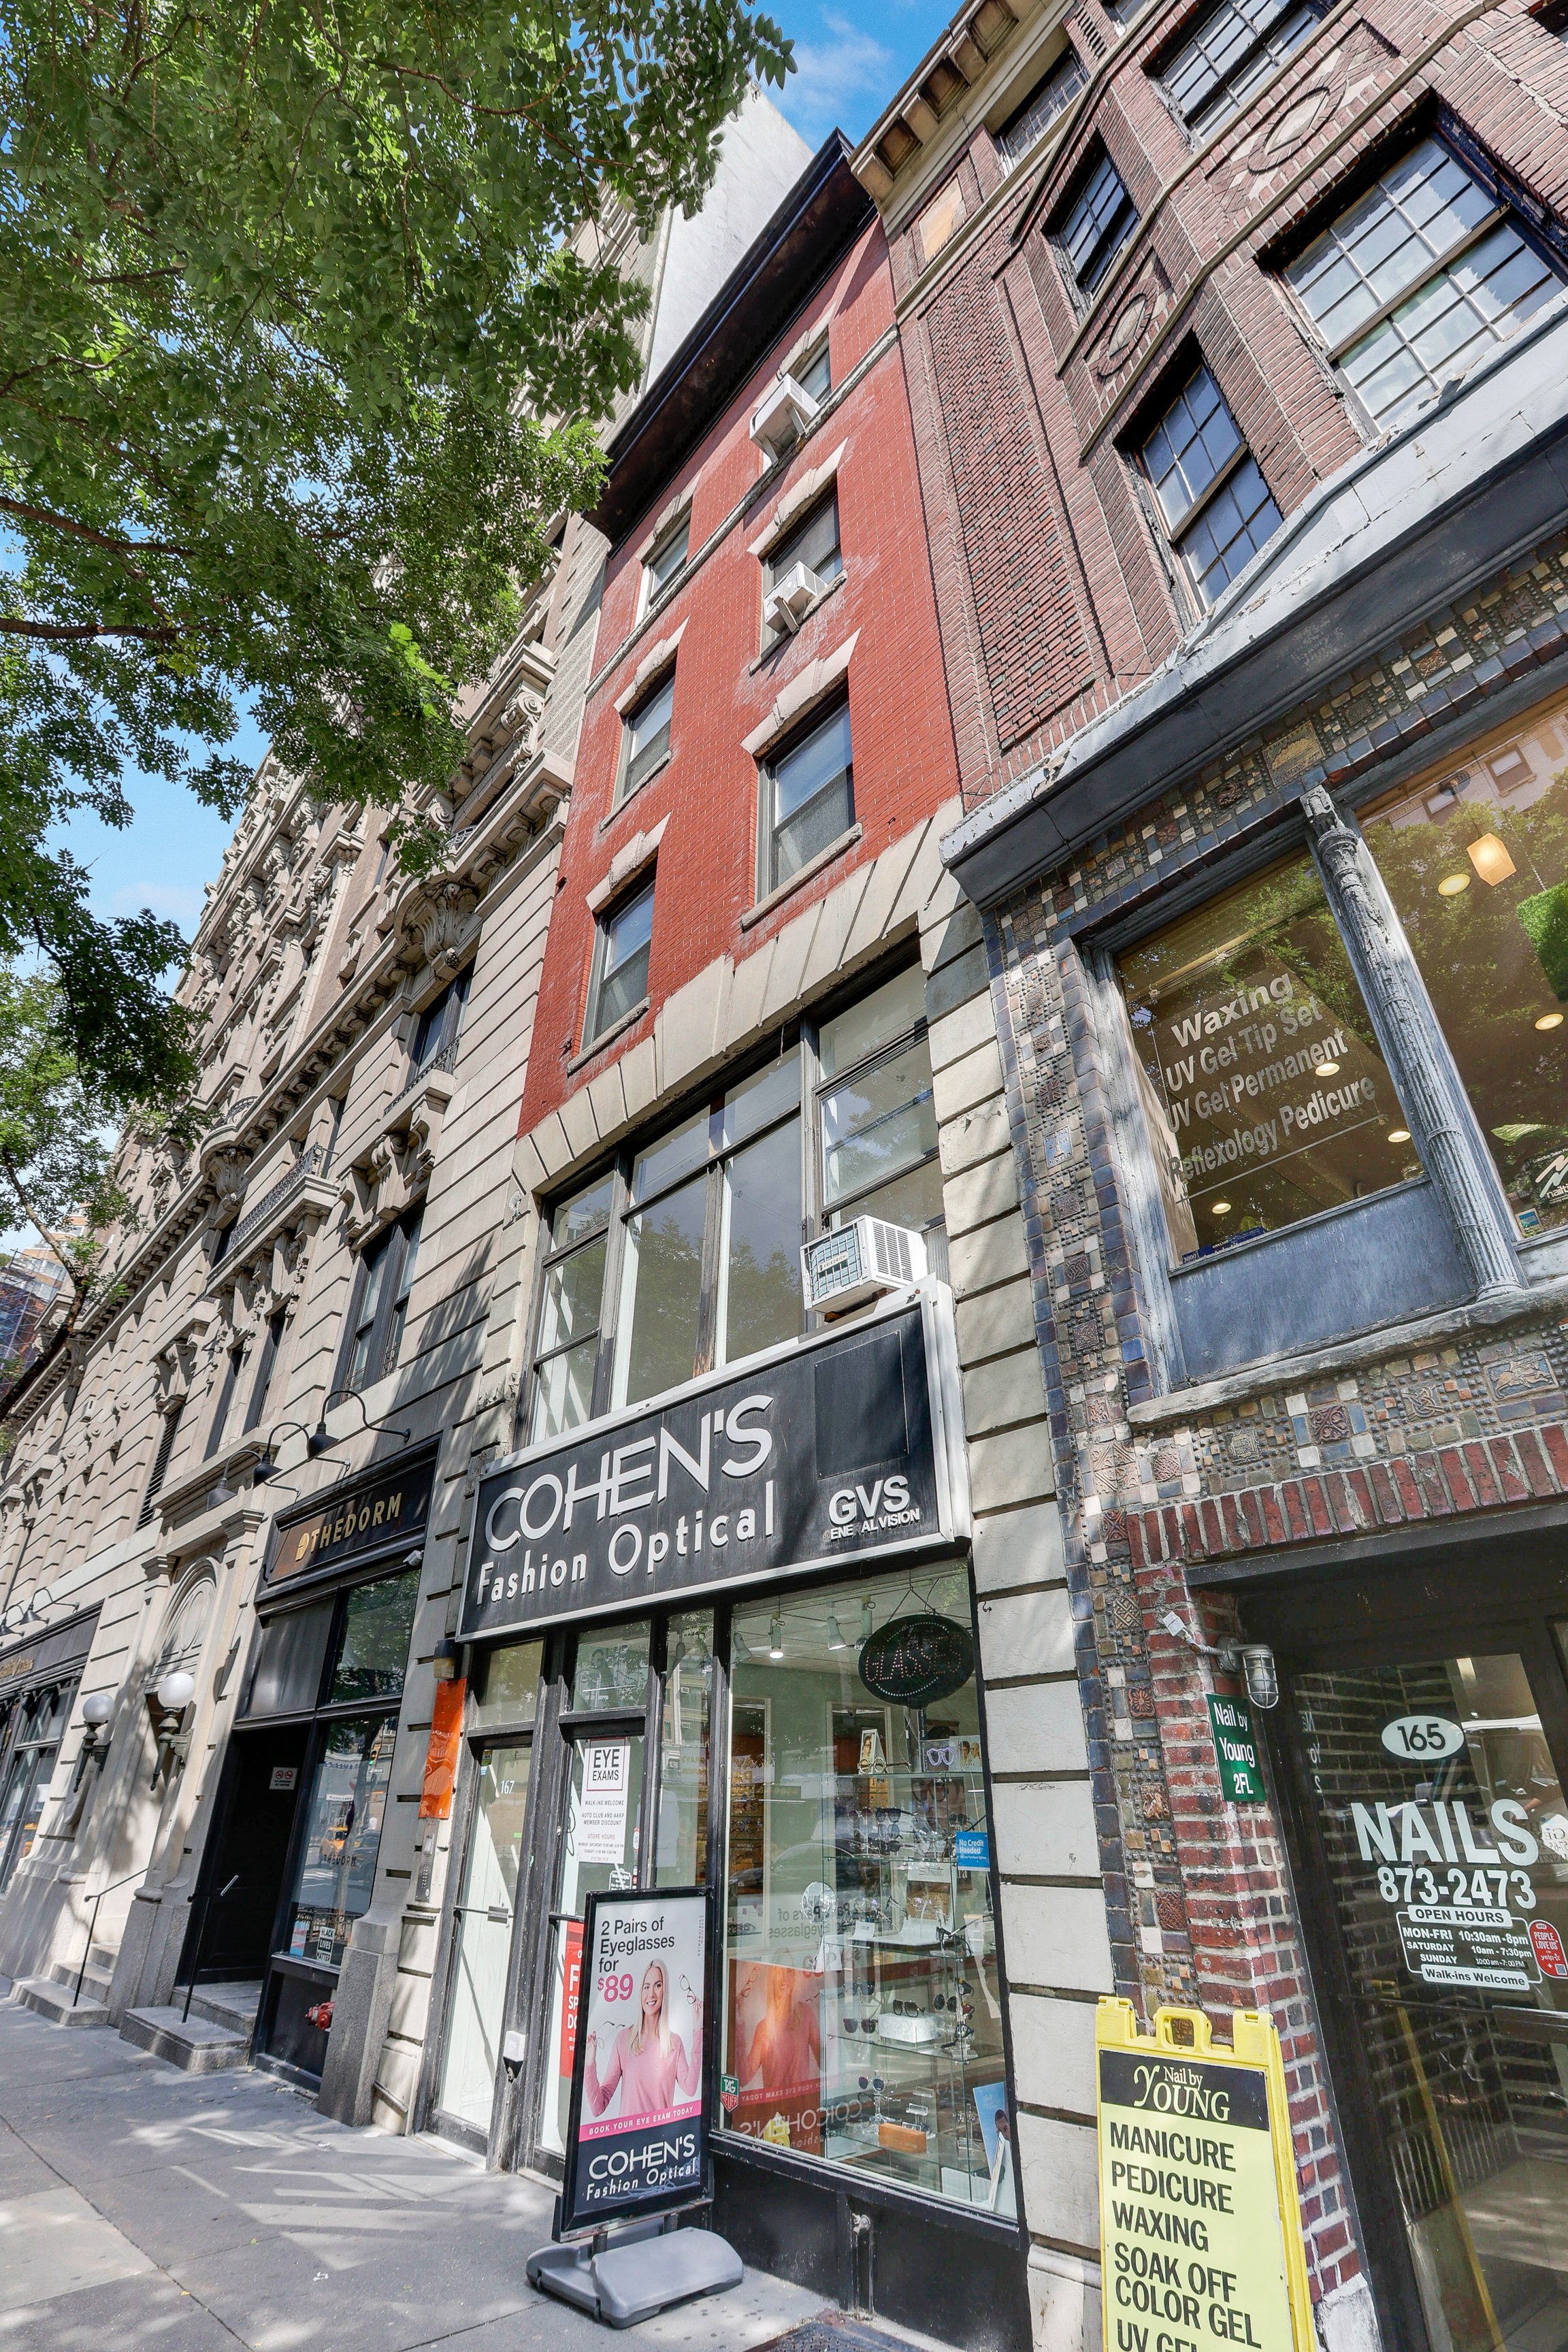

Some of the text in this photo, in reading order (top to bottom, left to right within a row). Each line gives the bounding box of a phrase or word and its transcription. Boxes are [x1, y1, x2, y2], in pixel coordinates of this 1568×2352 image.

[1171, 973, 1294, 1047] Waxing
[1166, 996, 1322, 1091] UV Gel Tip Set
[1165, 1027, 1348, 1133] UV Gel Permanent
[1169, 1077, 1375, 1186] Reflexology Pedicure
[484, 1394, 774, 1552] COHEN'S
[828, 1475, 910, 1526] GVS
[878, 1508, 920, 1531] VISION
[476, 1480, 774, 1606] Fashion Optical
[1213, 1702, 1247, 1732] Nail by
[1397, 1723, 1446, 1752] 165
[593, 1748, 620, 1768] EYE
[1219, 1737, 1256, 1768] Young
[501, 1780, 515, 1795] 167
[592, 1769, 619, 1781] EXAMS
[1233, 1773, 1254, 1795] 2FL
[968, 1839, 984, 1847] Credit
[1351, 1799, 1539, 1866] NAILS
[323, 1854, 357, 1867] THEDORM
[1377, 1866, 1537, 1909] 873-2473
[601, 1916, 664, 1936] 2 Pairs of
[1416, 1908, 1505, 1923] OPEN HOURS
[319, 1939, 331, 1950] LIVES
[321, 1927, 334, 1938] BLACK
[1402, 1927, 1453, 1940] MON-FRI
[1458, 1930, 1502, 1944] 10:30am
[1533, 1931, 1554, 1941] PEOPLE
[1535, 1940, 1550, 1949] LOVE
[316, 1950, 331, 1962] MATTER
[600, 1936, 675, 1957] Eyeglasses
[1406, 1942, 1454, 1952] SATURDAY
[1471, 1945, 1494, 1955] 10am
[1420, 1954, 1457, 1964] SUNDAY
[598, 1957, 619, 1973] for
[1424, 1968, 1526, 1986] Walk-ins Welcome
[598, 1974, 634, 2002] $89
[723, 2078, 736, 2094] TAG
[1162, 2066, 1203, 2091] Nail by
[721, 2093, 738, 2110] HEUER
[1133, 2065, 1230, 2122] YOUNG
[589, 2106, 693, 2136] BOOK YOUR EYE EXAM TODAY
[589, 2134, 696, 2180] COHEN'S
[1110, 2121, 1237, 2172] MANICURE
[586, 2157, 697, 2201] Fashion Optical
[1111, 2160, 1235, 2215] PEDICURE
[1111, 2200, 1209, 2253] WAXING
[1114, 2242, 1237, 2304] SOAK OFF
[1115, 2275, 1262, 2350] COLOR GEL
[1117, 2318, 1149, 2352] UV
